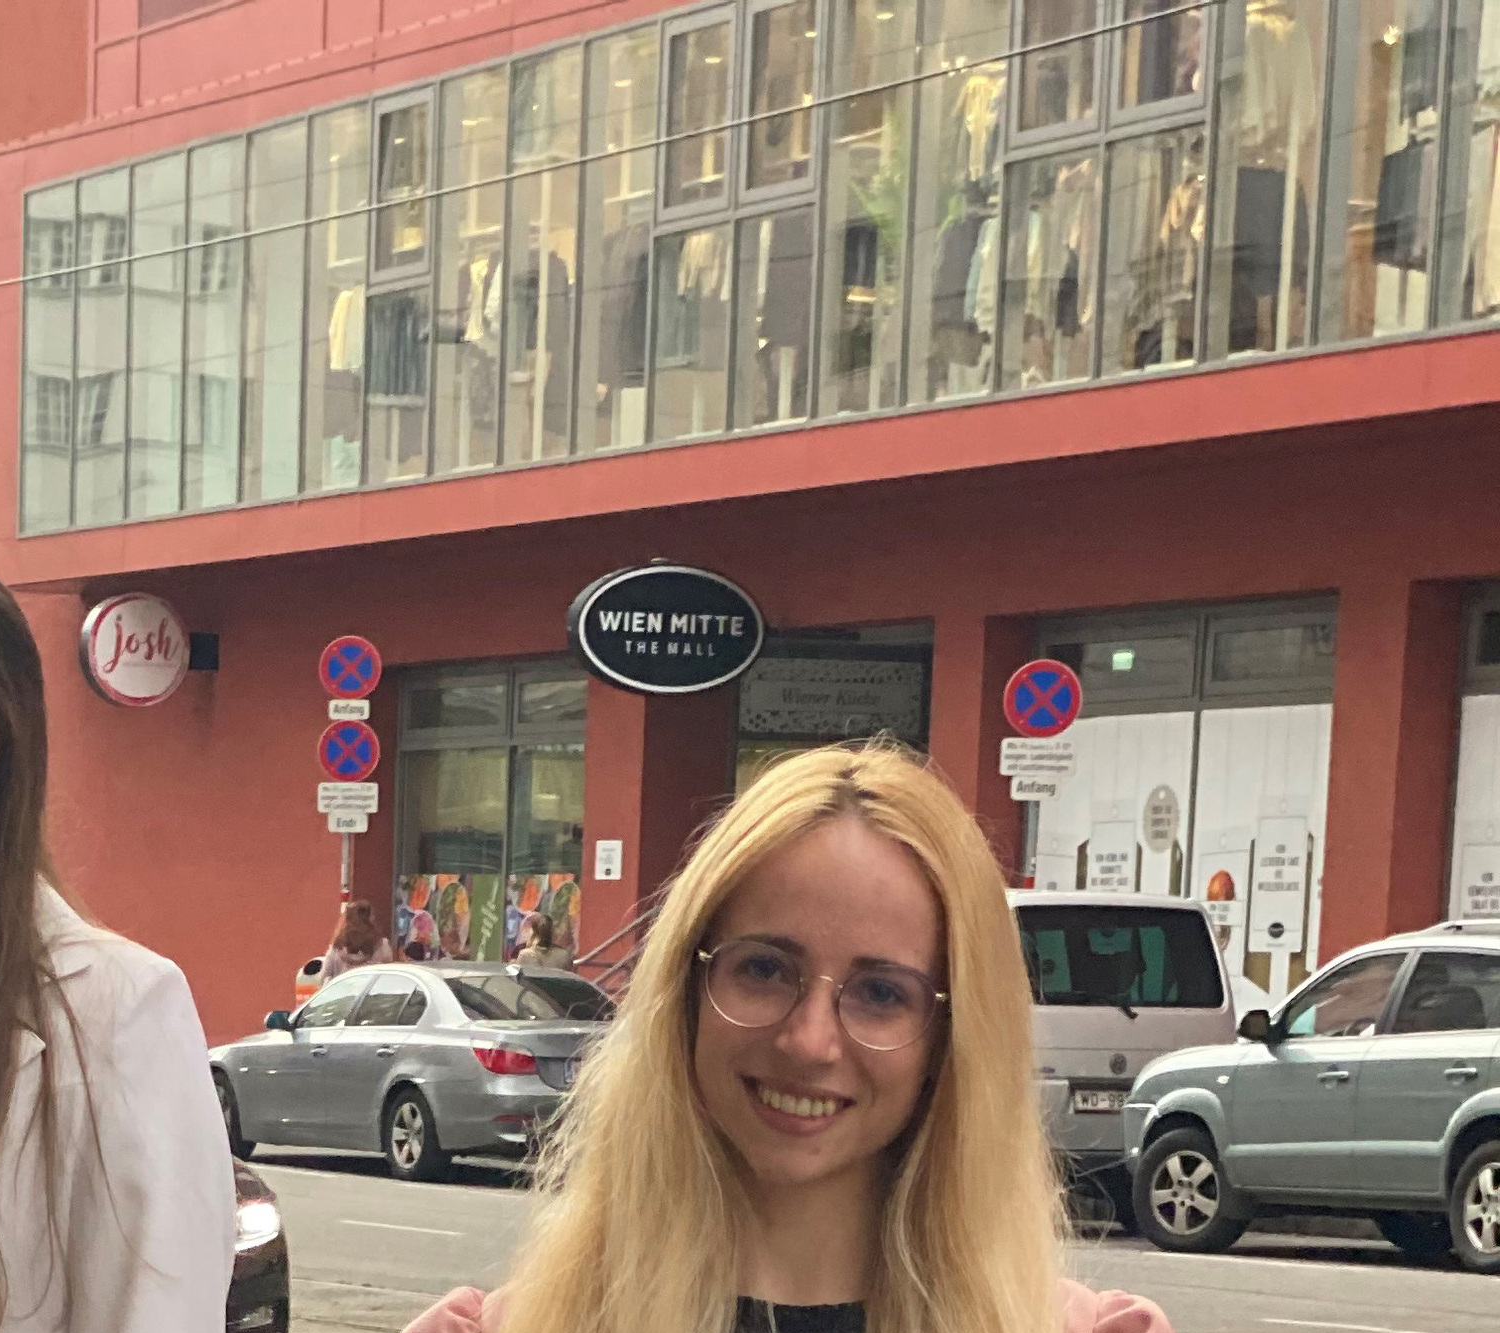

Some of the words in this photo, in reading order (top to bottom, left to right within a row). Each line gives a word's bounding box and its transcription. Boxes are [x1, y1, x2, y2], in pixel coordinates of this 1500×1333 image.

[600, 610, 663, 633] WIEN
[670, 613, 744, 637] MITTE
[624, 640, 658, 656] THE
[666, 641, 717, 658] MALL
[333, 703, 365, 717] Anfang
[1016, 780, 1056, 797] Anfang
